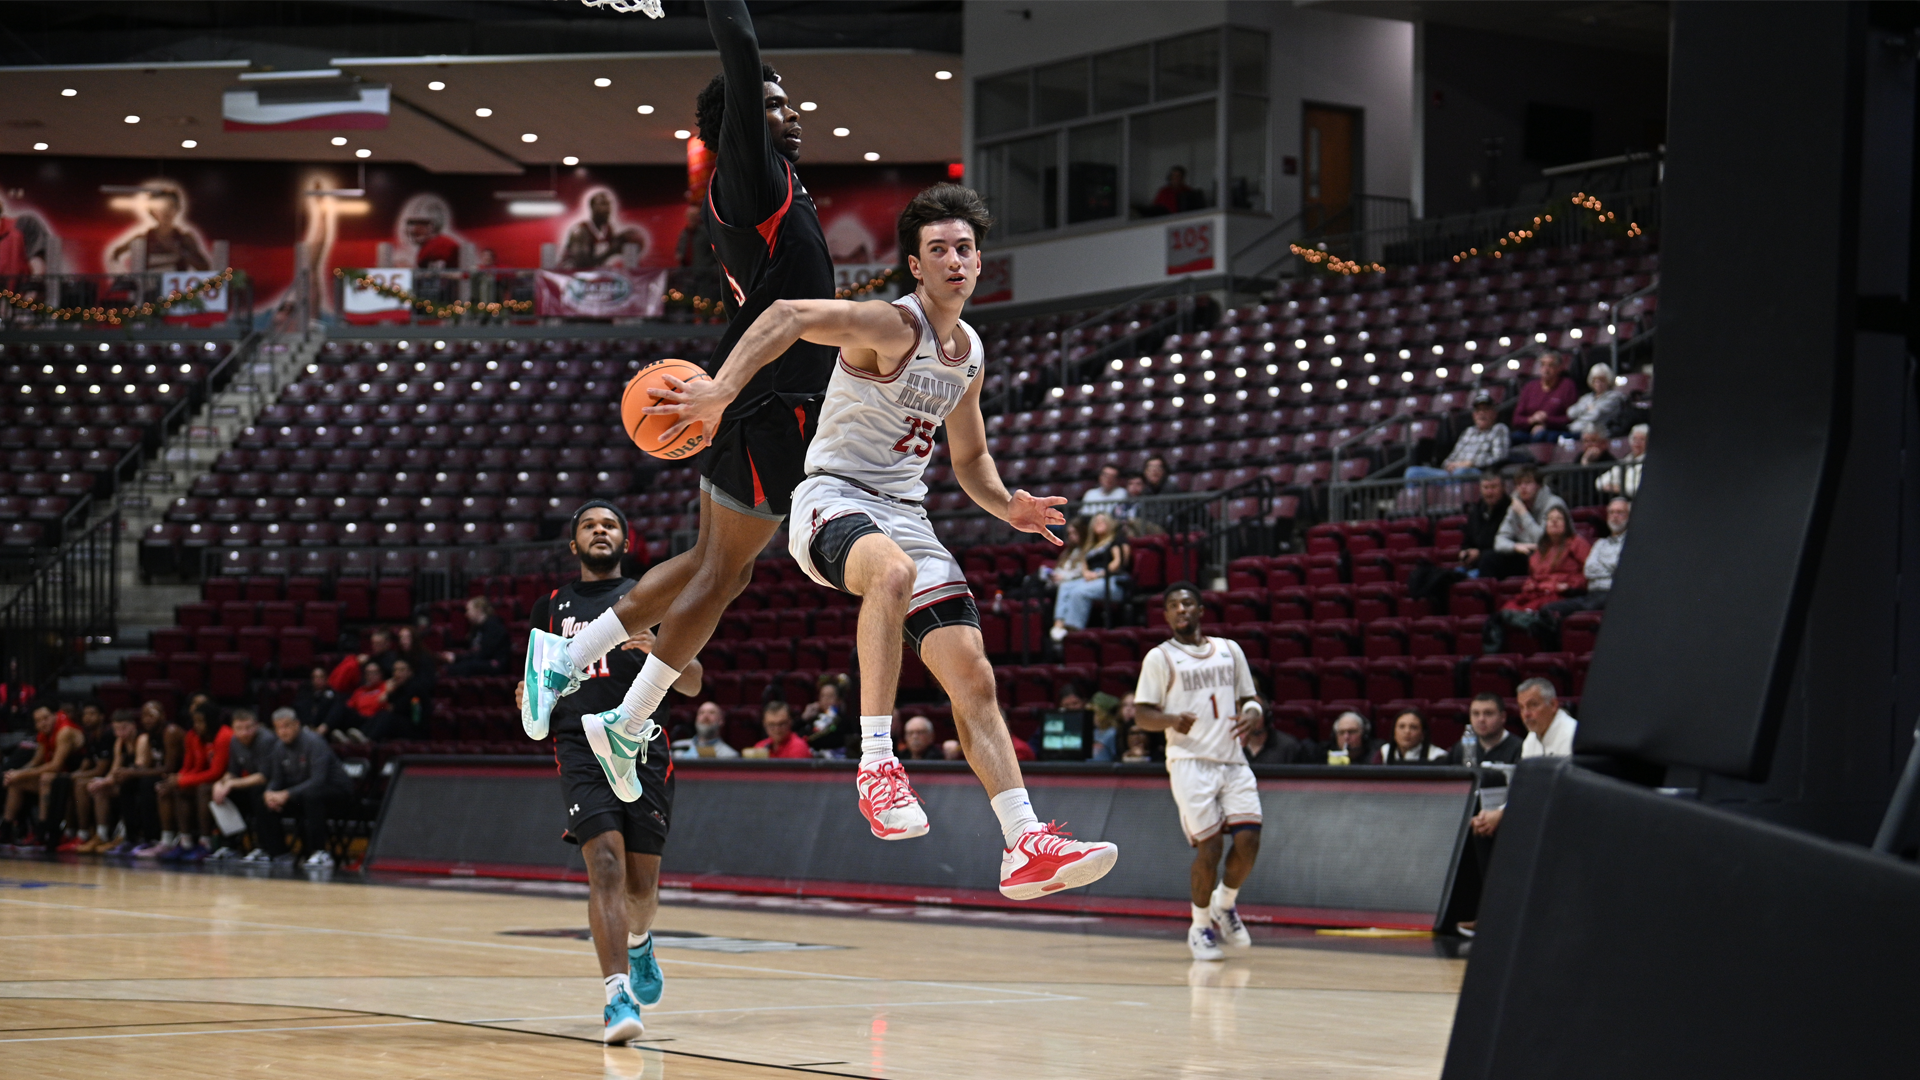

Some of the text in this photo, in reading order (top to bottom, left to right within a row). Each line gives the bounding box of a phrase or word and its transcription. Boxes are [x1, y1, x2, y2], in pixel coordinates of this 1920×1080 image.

[1172, 225, 1210, 254] 105
[891, 415, 936, 457] 25
[1181, 665, 1234, 691] HAWKS
[1210, 693, 1219, 719] 1
